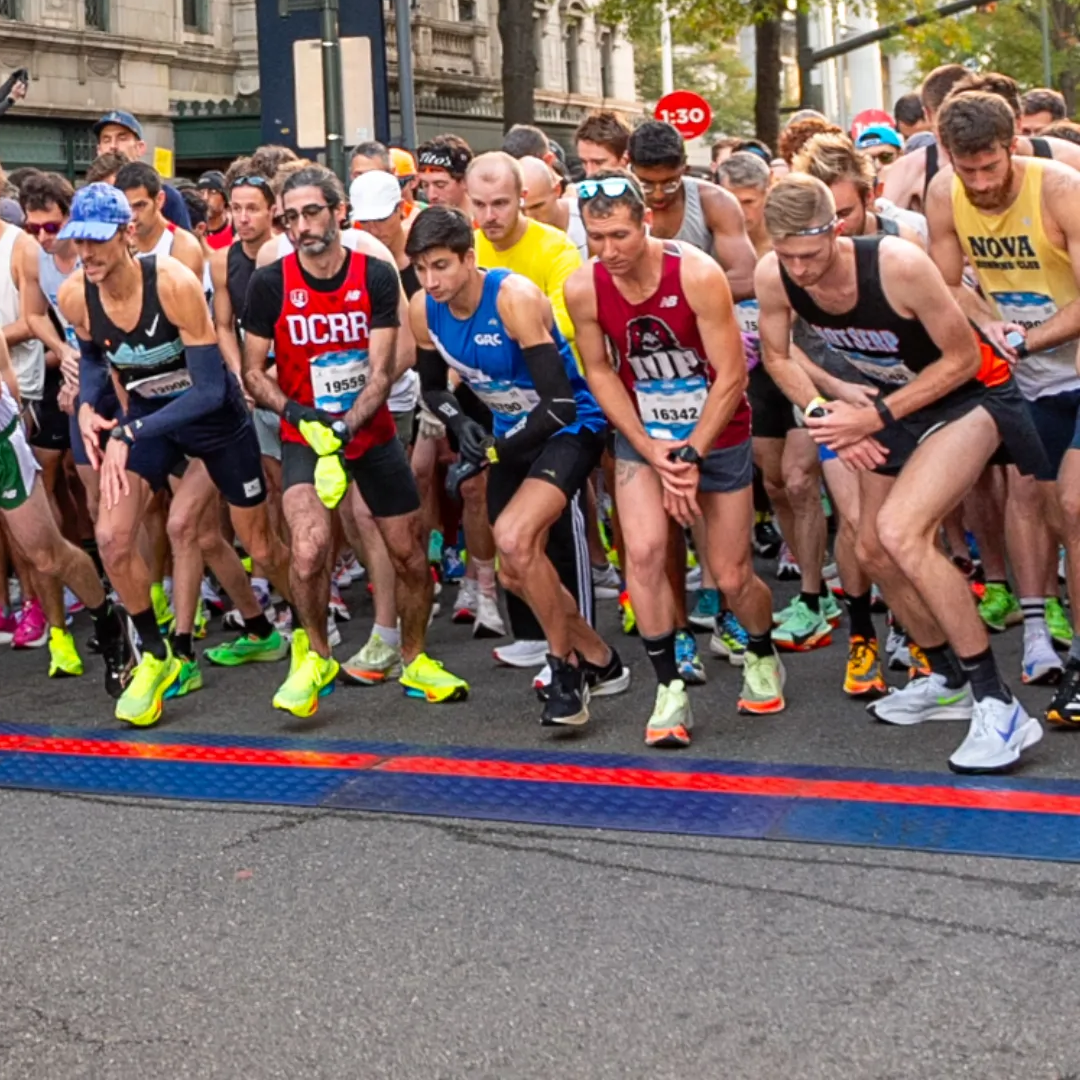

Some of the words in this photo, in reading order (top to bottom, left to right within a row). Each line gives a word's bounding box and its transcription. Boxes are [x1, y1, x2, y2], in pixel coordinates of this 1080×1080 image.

[659, 108, 705, 125] 1:30
[419, 152, 452, 167] Tito's
[968, 235, 1036, 258] NOVA
[1016, 260, 1040, 271] CLUB
[285, 311, 369, 346] DCRR
[474, 333, 503, 347] GRC
[324, 374, 366, 393] 19559
[652, 407, 699, 421] 16342
